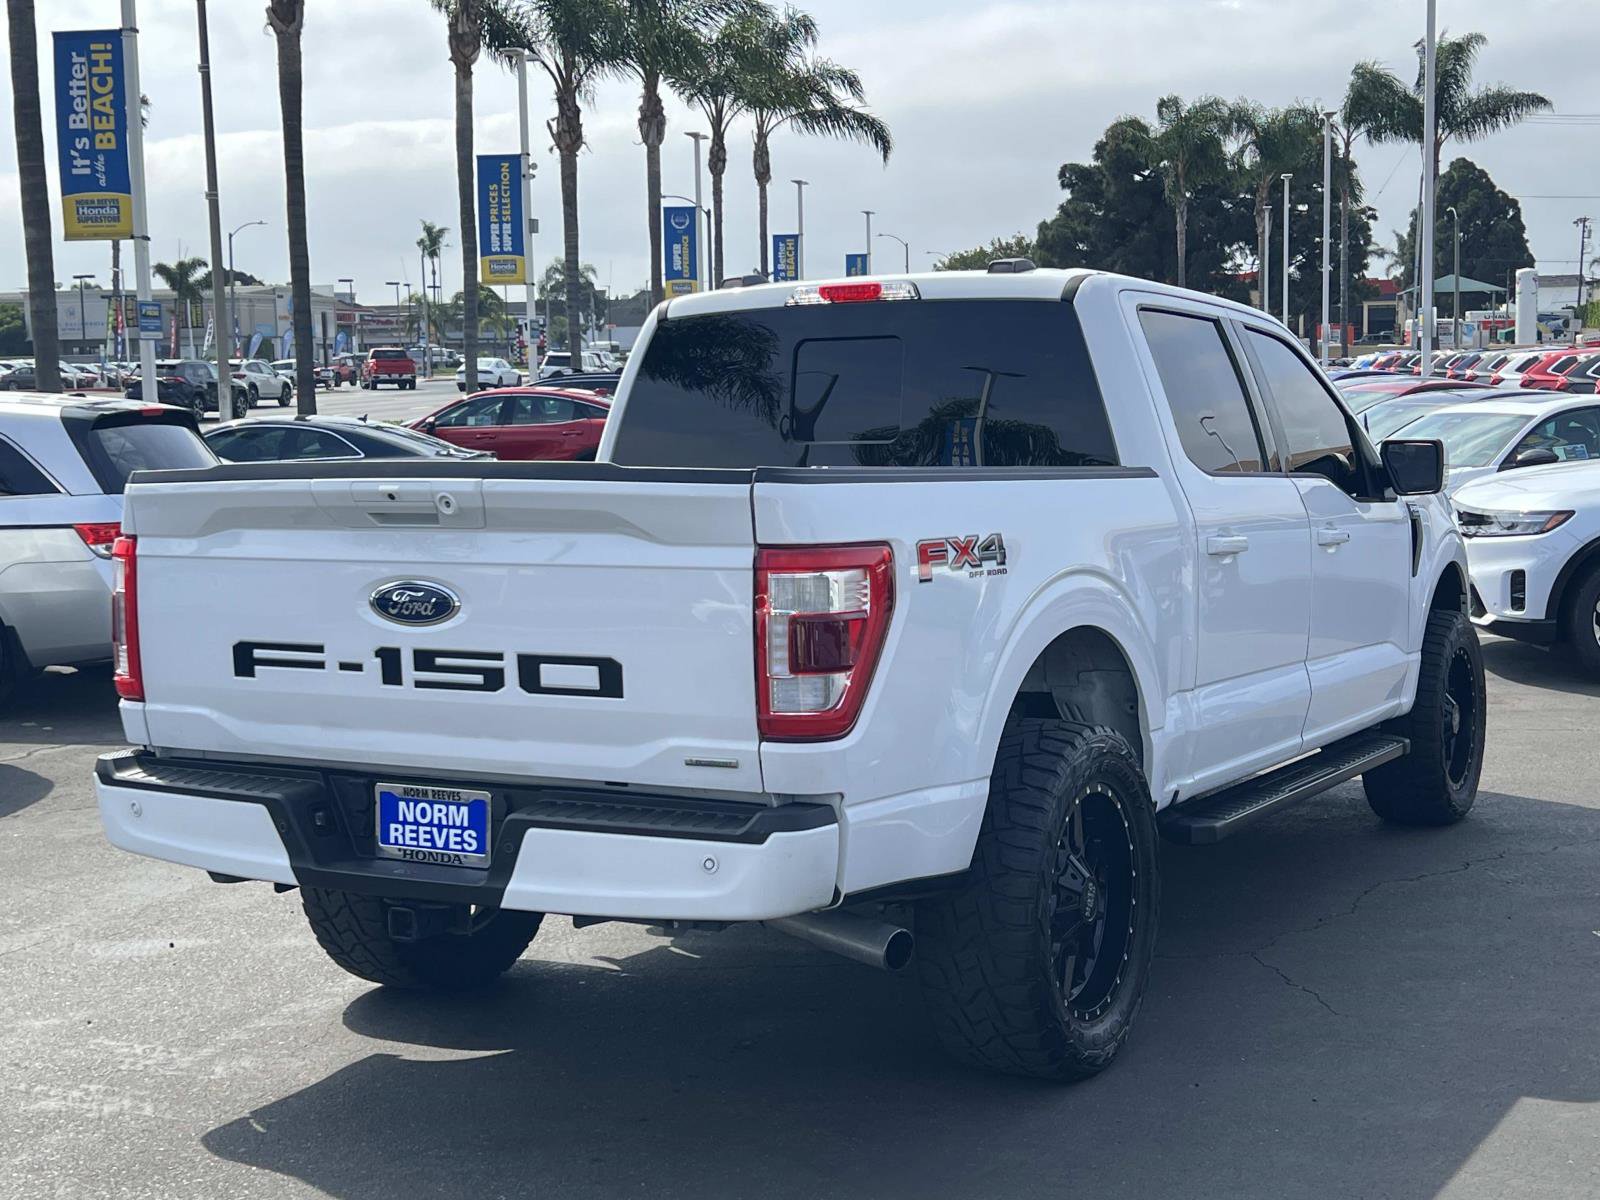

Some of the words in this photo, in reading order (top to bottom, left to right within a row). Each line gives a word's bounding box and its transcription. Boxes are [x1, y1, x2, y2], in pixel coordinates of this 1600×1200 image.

[68, 51, 88, 129] Better
[90, 43, 116, 149] BEACH!
[70, 137, 91, 174] It's
[93, 153, 104, 173] the
[489, 184, 499, 222] PRICES
[501, 162, 511, 222] SELECTION
[78, 206, 118, 215] Honda
[490, 223, 500, 252] SUPER
[502, 223, 512, 252] SUPER
[673, 243, 682, 271] SUPER
[915, 533, 1007, 584] FX4
[969, 571, 985, 579] OFF
[986, 568, 1008, 577] ROAD
[388, 590, 436, 616] Ford
[232, 641, 624, 699] F-150
[402, 787, 429, 799] NORM
[431, 789, 461, 800] REEVES
[398, 801, 469, 827] NORM
[389, 823, 478, 851] REEVES
[402, 849, 464, 865] HONDA
